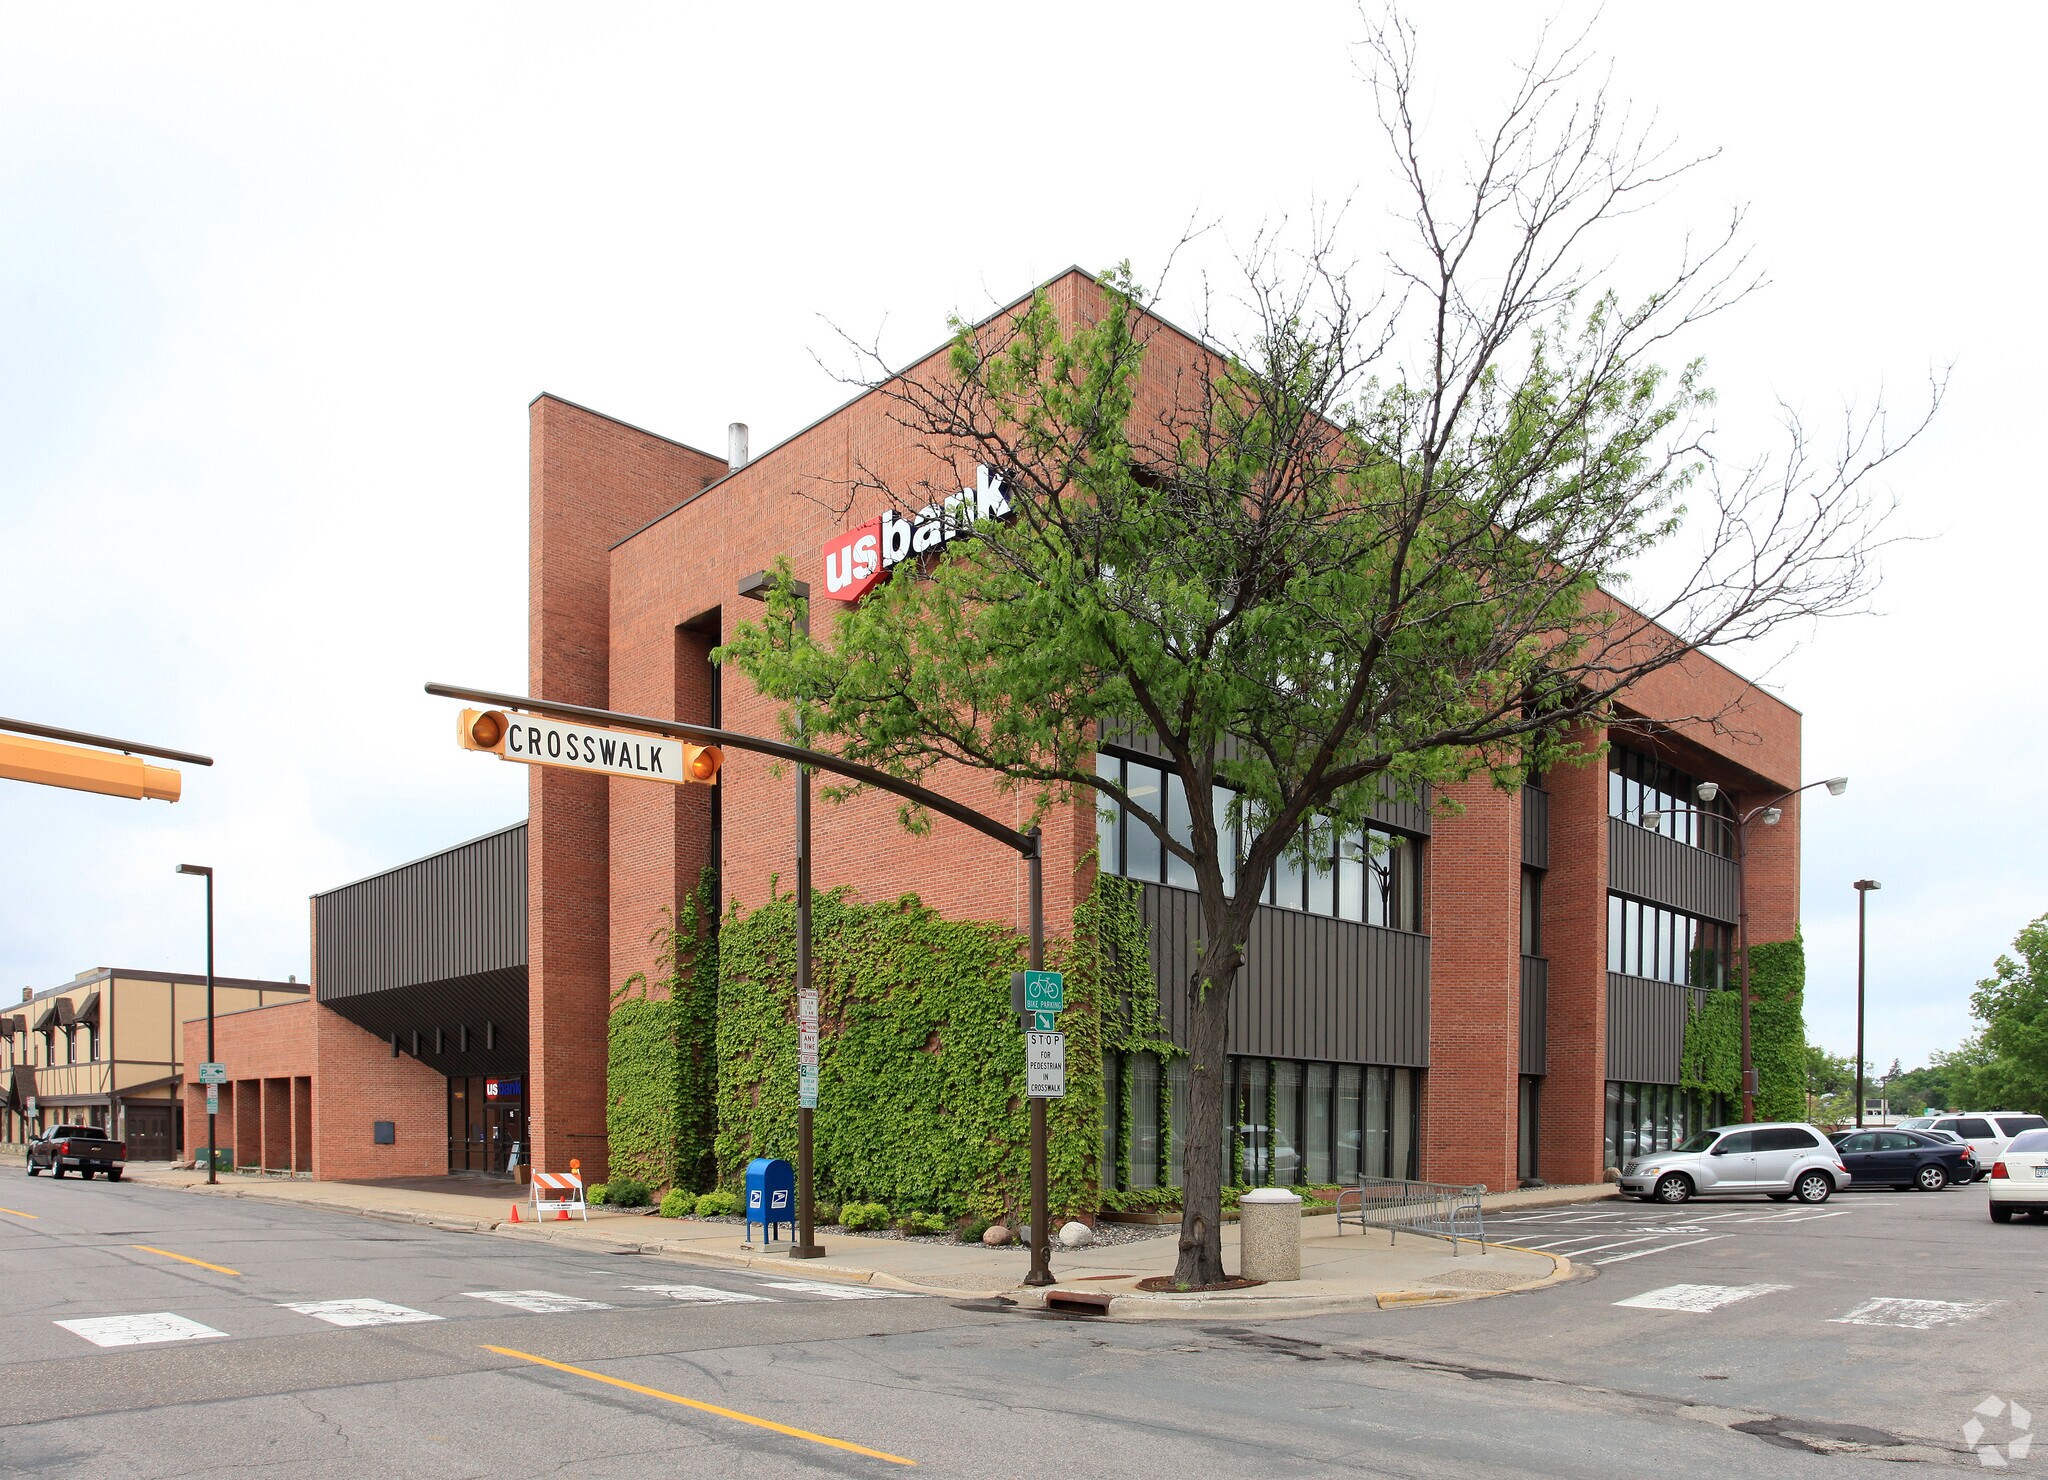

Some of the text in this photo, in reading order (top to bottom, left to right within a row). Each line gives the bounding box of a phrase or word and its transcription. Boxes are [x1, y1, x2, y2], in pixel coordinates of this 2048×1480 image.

[509, 724, 663, 774] CROSSWALK
[1027, 1000, 1062, 1009] BIKE PARKING
[1031, 1034, 1060, 1045] STOP
[1040, 1051, 1051, 1059] FOR
[1030, 1062, 1062, 1070] PEDESTRIAN
[1043, 1073, 1049, 1081] IN
[1030, 1083, 1061, 1092] CROSSWALK
